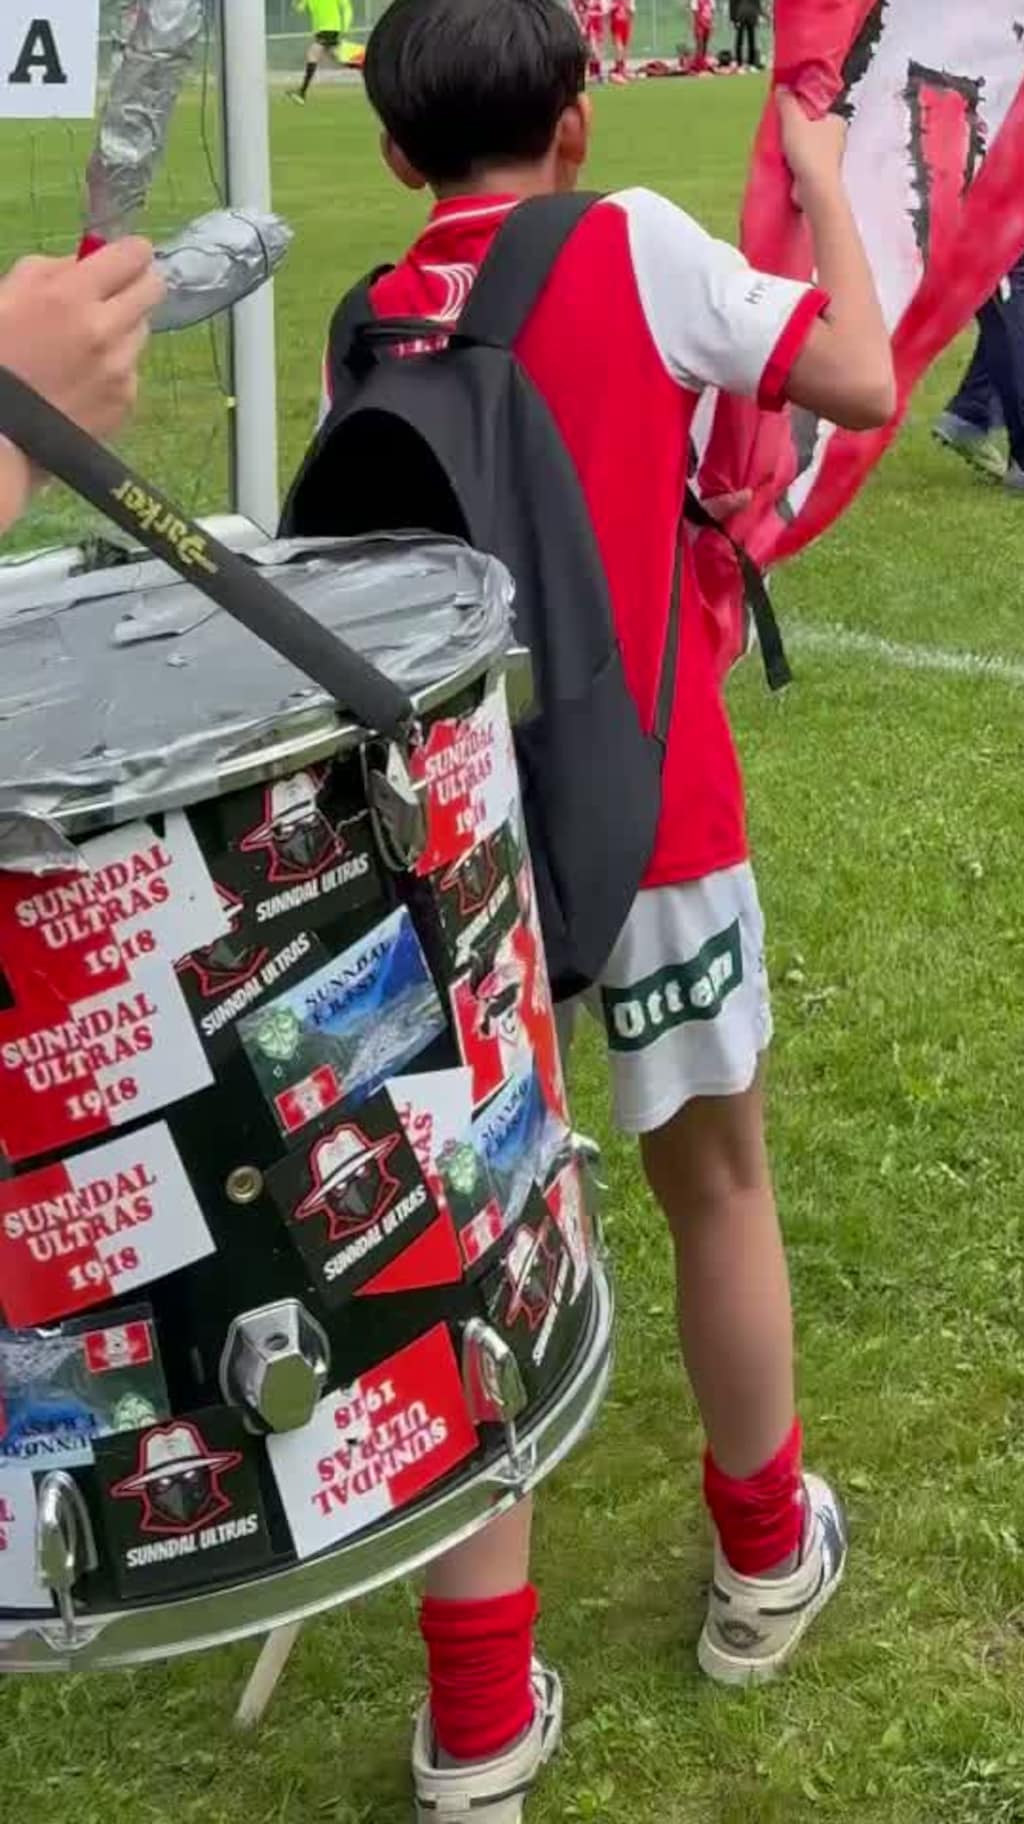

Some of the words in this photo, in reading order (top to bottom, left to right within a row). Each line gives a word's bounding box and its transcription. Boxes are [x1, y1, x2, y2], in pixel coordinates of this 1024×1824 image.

[8, 19, 67, 83] A
[14, 844, 172, 927] SUNNDAL
[40, 876, 170, 949] ULTRAS
[256, 877, 321, 922] SUNNDAL
[321, 852, 369, 895] ULTRAS
[83, 928, 157, 974] 1918
[201, 979, 265, 1037] SUNNDAL
[260, 930, 312, 986] ULTRAS
[1, 992, 157, 1069] SUNNDAL
[24, 1025, 154, 1091] ULTRAS
[65, 1077, 138, 1120] 1918
[3, 1163, 157, 1239] SUNNDAL
[26, 1196, 153, 1261] ULTRAS
[68, 1246, 140, 1290] 1918
[323, 1224, 384, 1281] SUNNDAL
[333, 1379, 396, 1430] 1918
[311, 1416, 449, 1517] SUNNDAL
[317, 1400, 430, 1482] ULTRAS
[126, 1532, 198, 1568] SUNNDAL
[199, 1514, 258, 1548] ULTRAS
